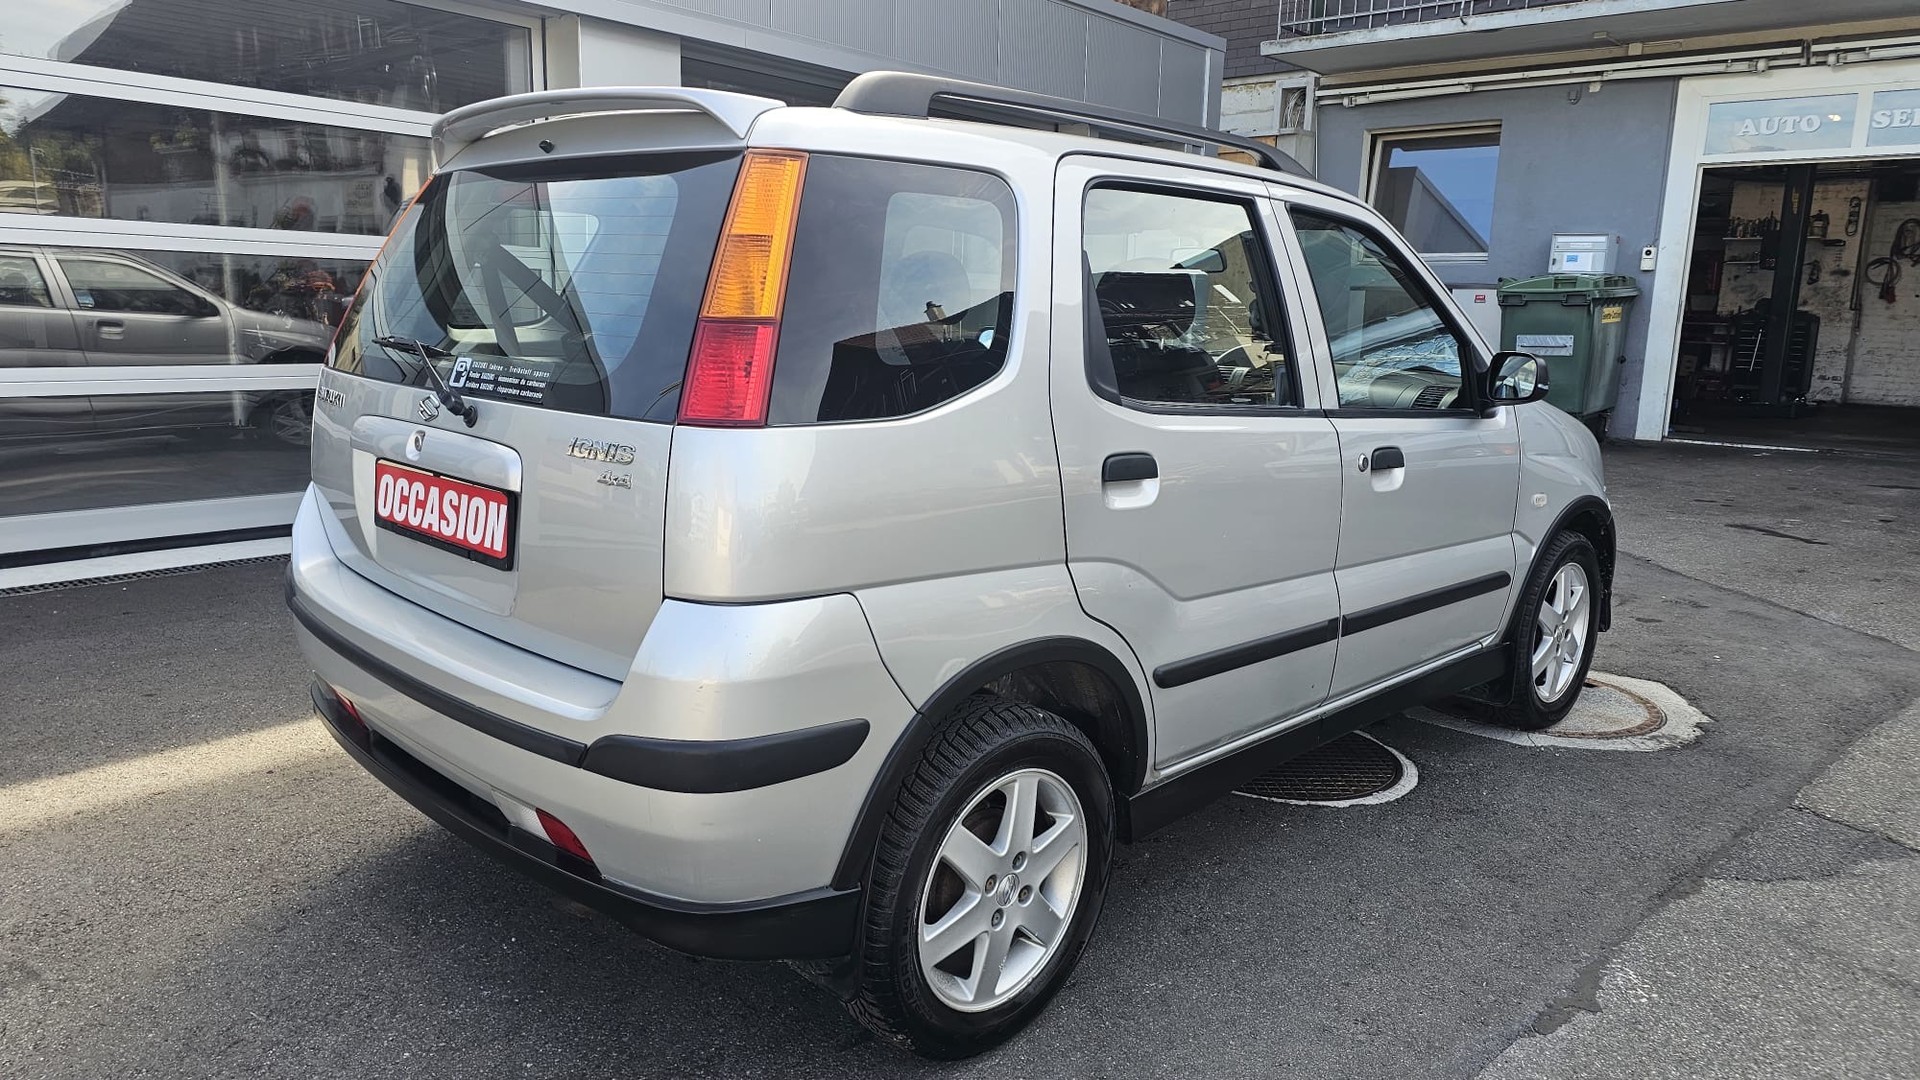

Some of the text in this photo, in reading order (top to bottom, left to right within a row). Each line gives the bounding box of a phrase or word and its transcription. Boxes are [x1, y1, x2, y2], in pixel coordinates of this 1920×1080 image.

[1737, 114, 1822, 137] AUTO
[317, 386, 346, 408] SUZUKI
[566, 437, 636, 466] IGNIS
[377, 474, 508, 552] OCCASION
